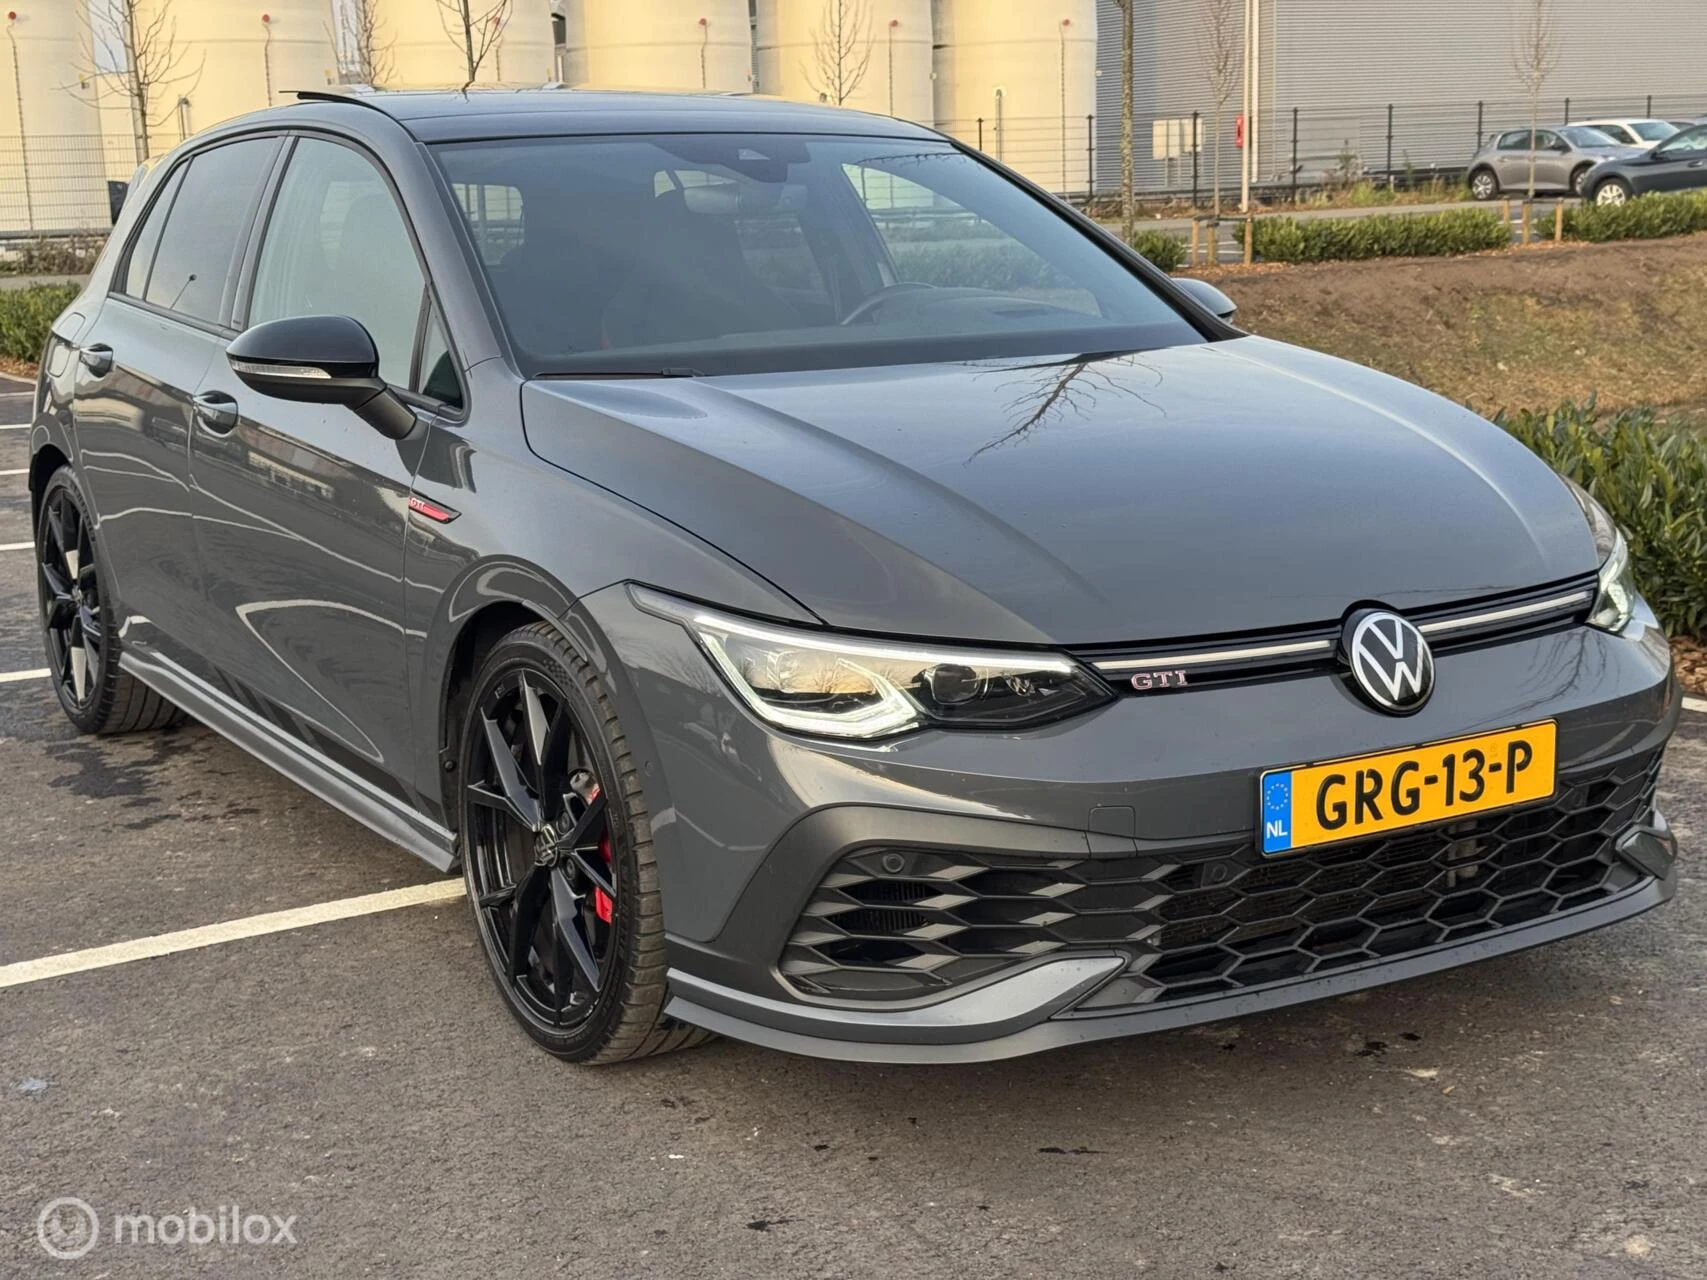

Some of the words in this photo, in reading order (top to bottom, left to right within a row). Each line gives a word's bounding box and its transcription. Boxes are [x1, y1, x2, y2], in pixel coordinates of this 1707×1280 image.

[1131, 669, 1188, 690] GTI
[1316, 740, 1533, 831] GRG-13-P
[1266, 819, 1288, 839] NL
